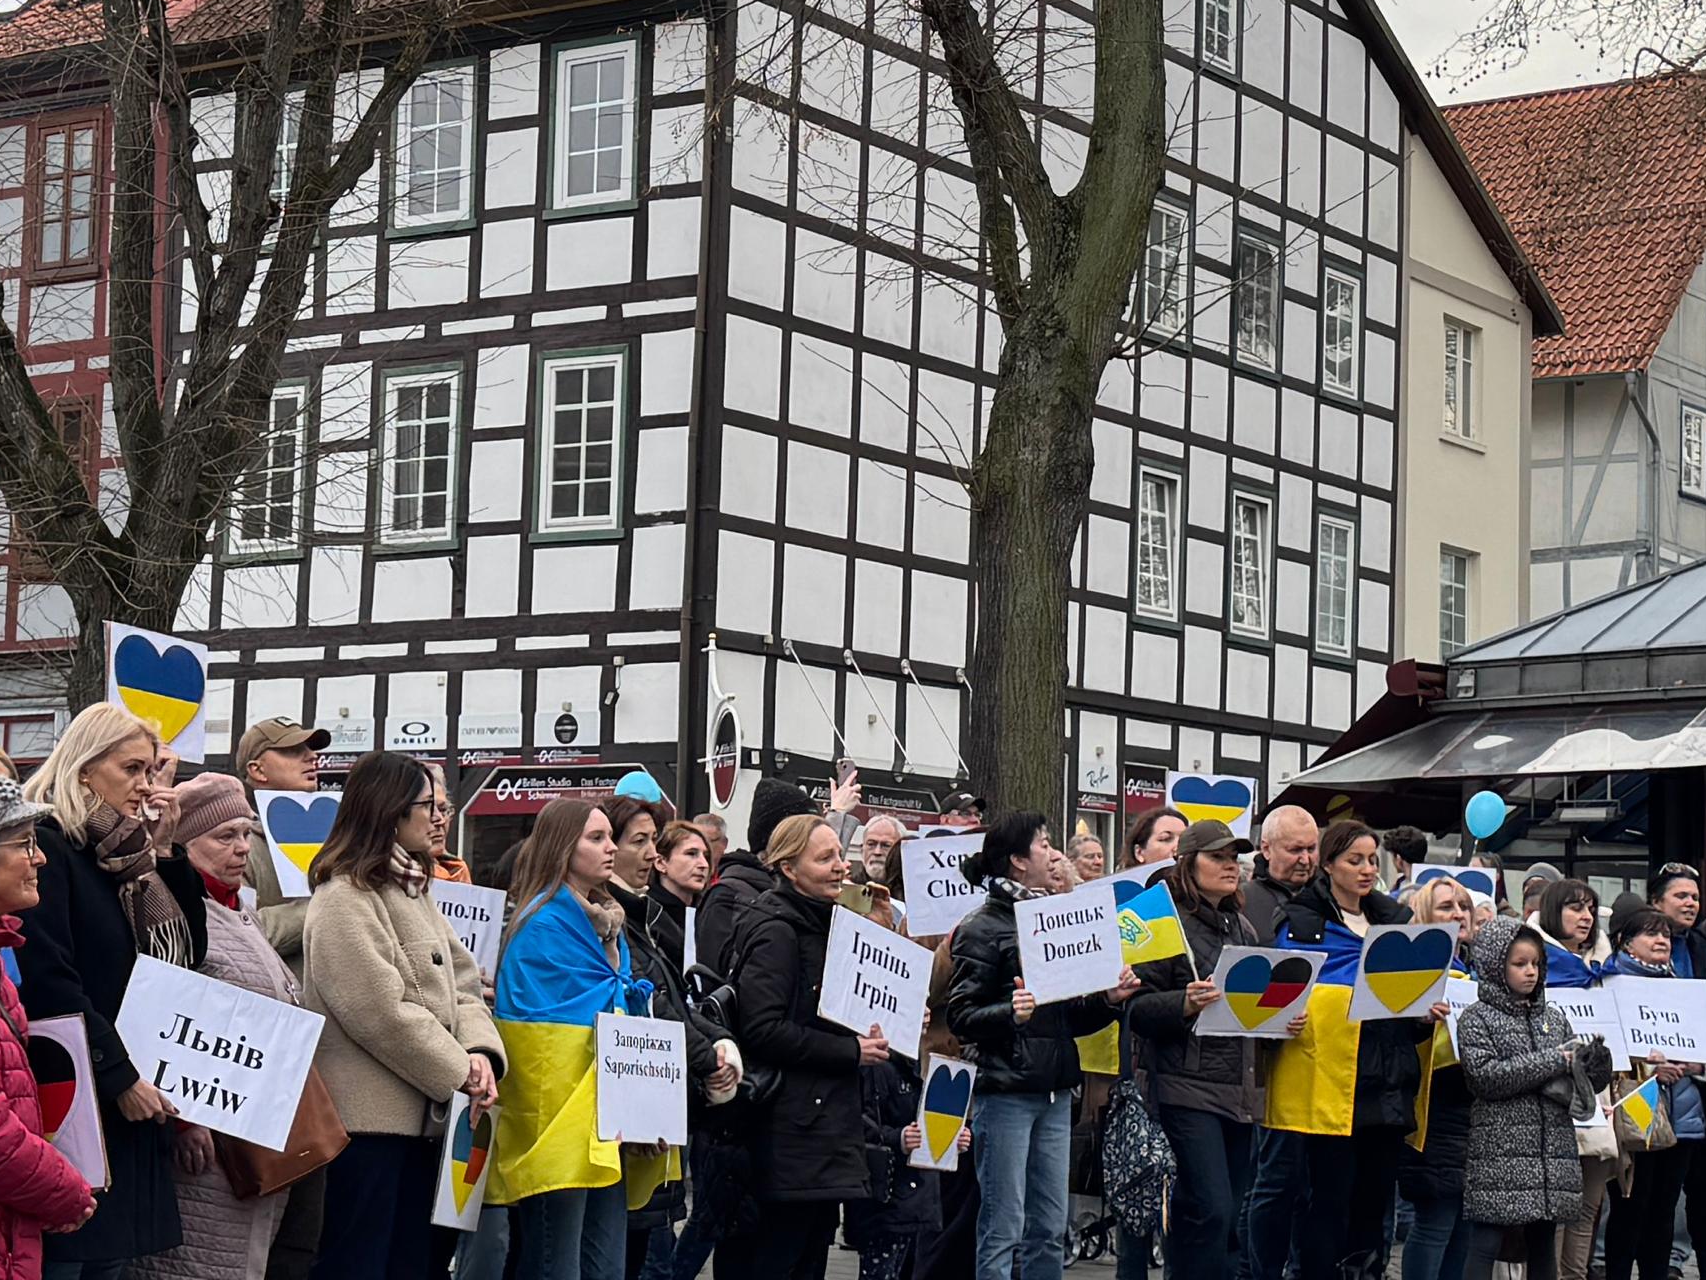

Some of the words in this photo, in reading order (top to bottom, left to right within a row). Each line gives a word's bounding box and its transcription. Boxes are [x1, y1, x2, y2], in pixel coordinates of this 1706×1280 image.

[522, 778, 546, 788] Brillen
[547, 777, 572, 788] Studio
[437, 901, 491, 922] поль
[1033, 906, 1104, 936] Донецьк
[852, 931, 910, 979] Ірпінь
[1043, 933, 1102, 962] Donezk
[854, 971, 898, 1013] Irpin
[1638, 1005, 1680, 1026] Буча
[159, 1013, 264, 1070] Львів
[613, 1029, 672, 1054] Запоріжжя
[1630, 1028, 1696, 1048] Butscha
[604, 1055, 681, 1084] Saporischschja
[153, 1059, 248, 1114] Lwiw
